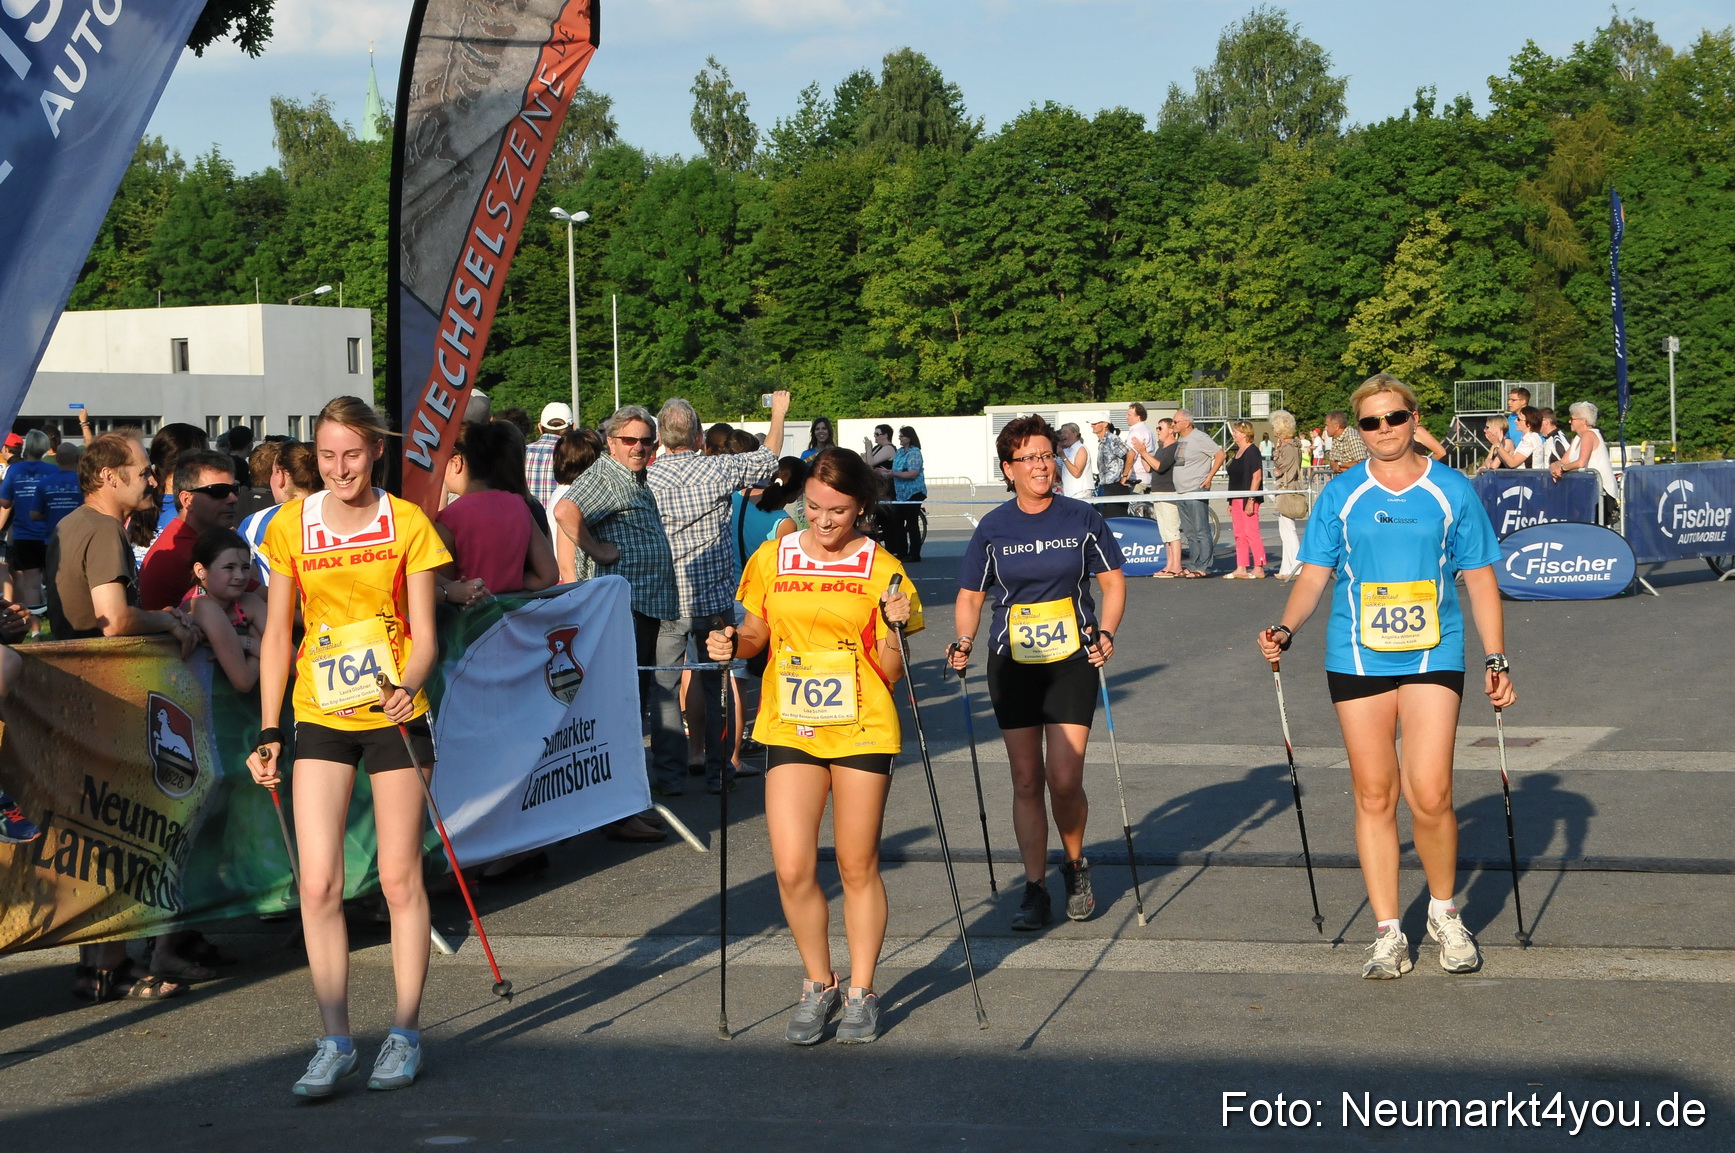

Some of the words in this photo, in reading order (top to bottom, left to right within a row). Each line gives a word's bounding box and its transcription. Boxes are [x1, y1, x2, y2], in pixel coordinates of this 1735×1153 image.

[1501, 510, 1568, 534] Fisch
[1673, 502, 1732, 530] Fischer
[1002, 544, 1034, 555] EURO
[1045, 538, 1078, 549] POLES
[1122, 542, 1164, 556] cher
[1678, 531, 1727, 544] AUTOMOBILE
[303, 556, 343, 572] MAX
[350, 548, 398, 565] BÖGL
[1526, 556, 1617, 575] Fischer
[774, 580, 814, 593] MAX
[821, 580, 867, 595] BÖGL
[1535, 574, 1611, 584] AUTOMOBILE
[1371, 605, 1426, 633] 483
[1019, 621, 1067, 648] 354
[318, 648, 382, 691] 764
[786, 677, 842, 707] 762
[161, 767, 184, 789] 1628
